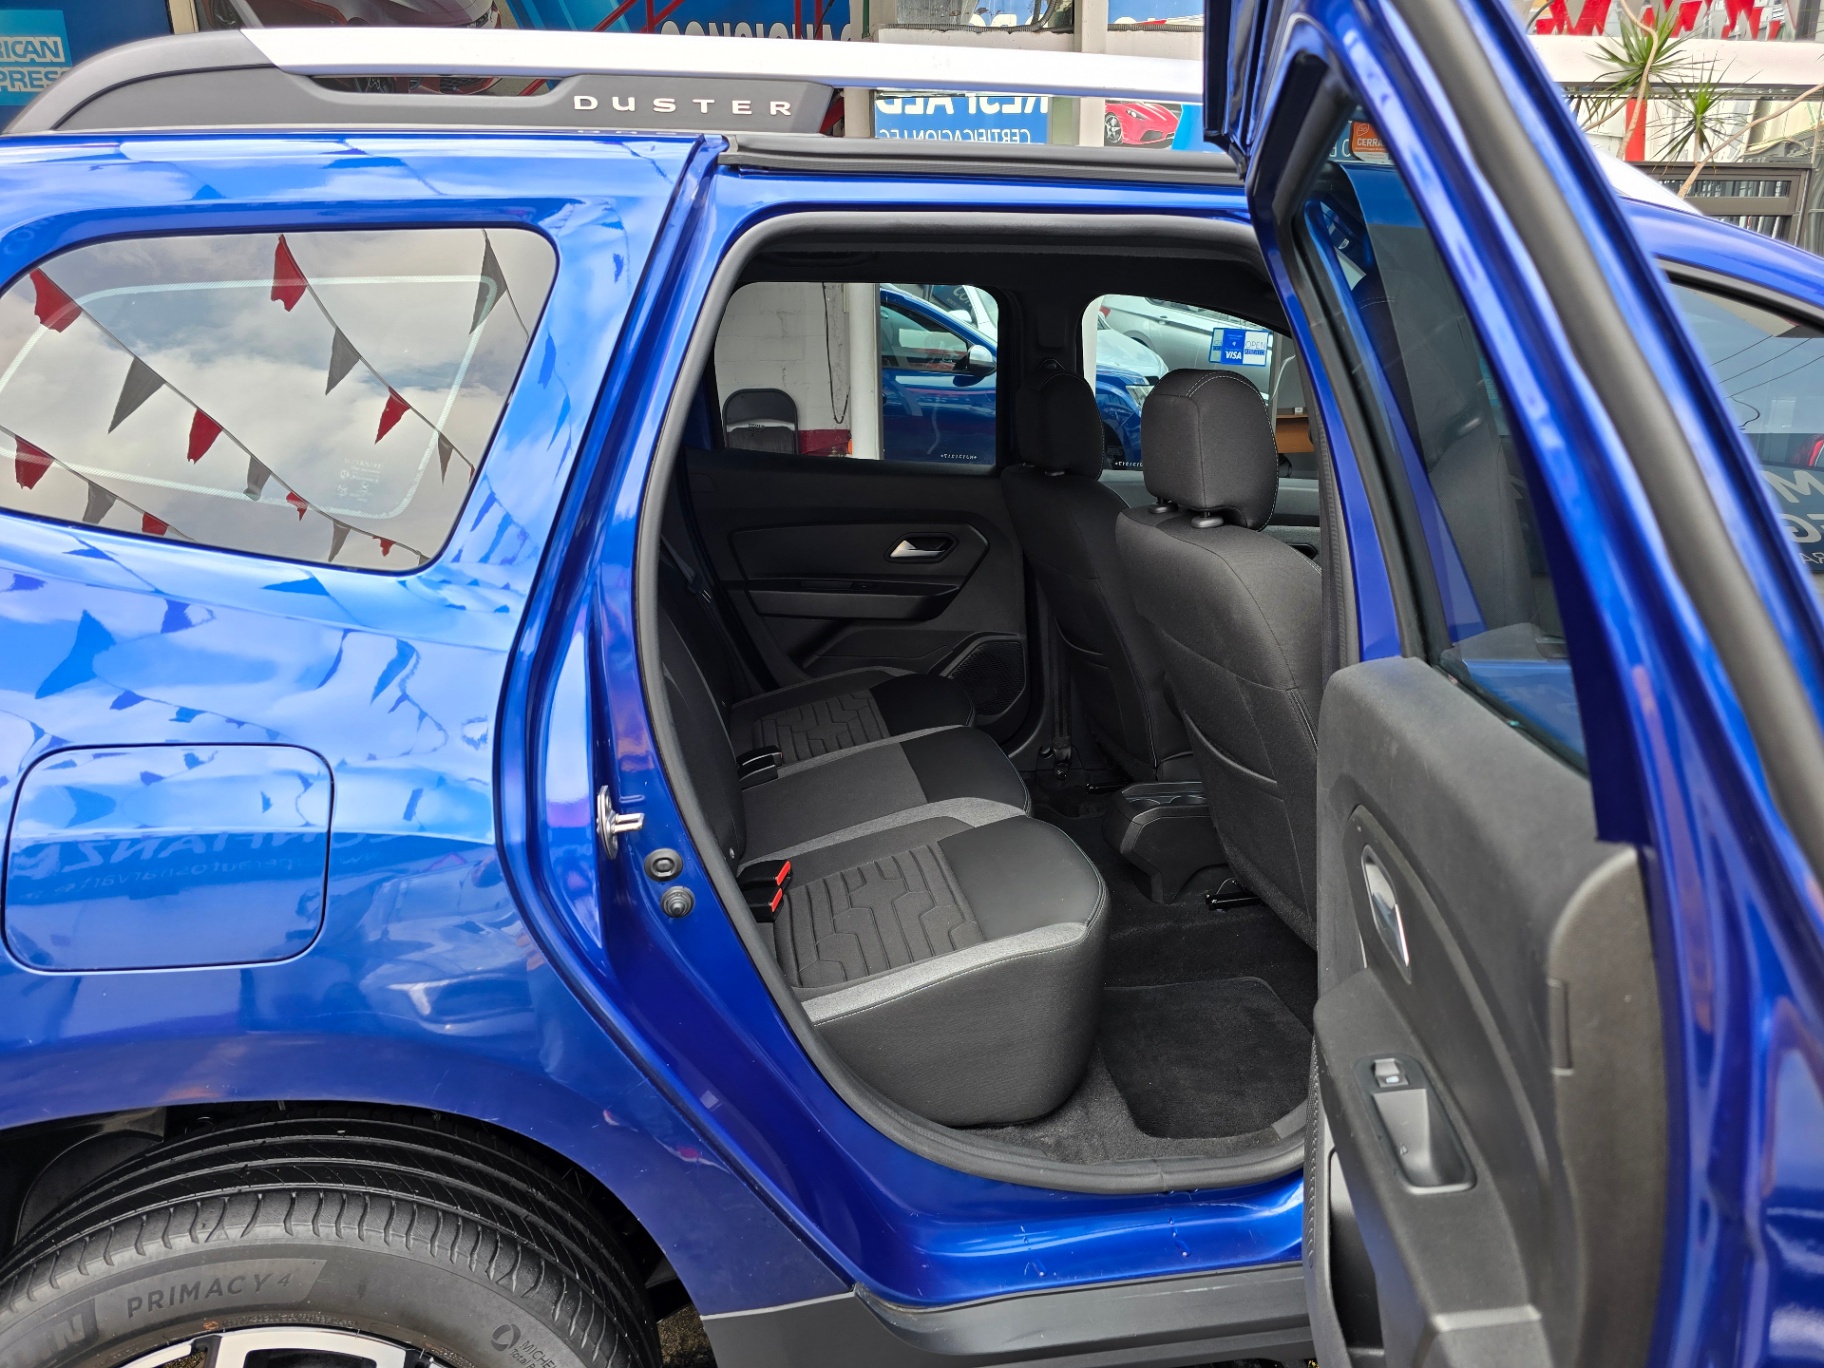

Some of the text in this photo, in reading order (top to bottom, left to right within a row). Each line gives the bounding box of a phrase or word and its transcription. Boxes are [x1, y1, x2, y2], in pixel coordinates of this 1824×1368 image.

[0, 39, 63, 60] ICAN
[0, 68, 69, 90] PRES
[573, 95, 792, 116] DUSTER
[1357, 138, 1383, 147] CERRA
[1226, 351, 1242, 359] VISA
[127, 1273, 292, 1319] PRIMACY 4
[509, 1348, 531, 1366] Total
[520, 1340, 557, 1368] MICHE
